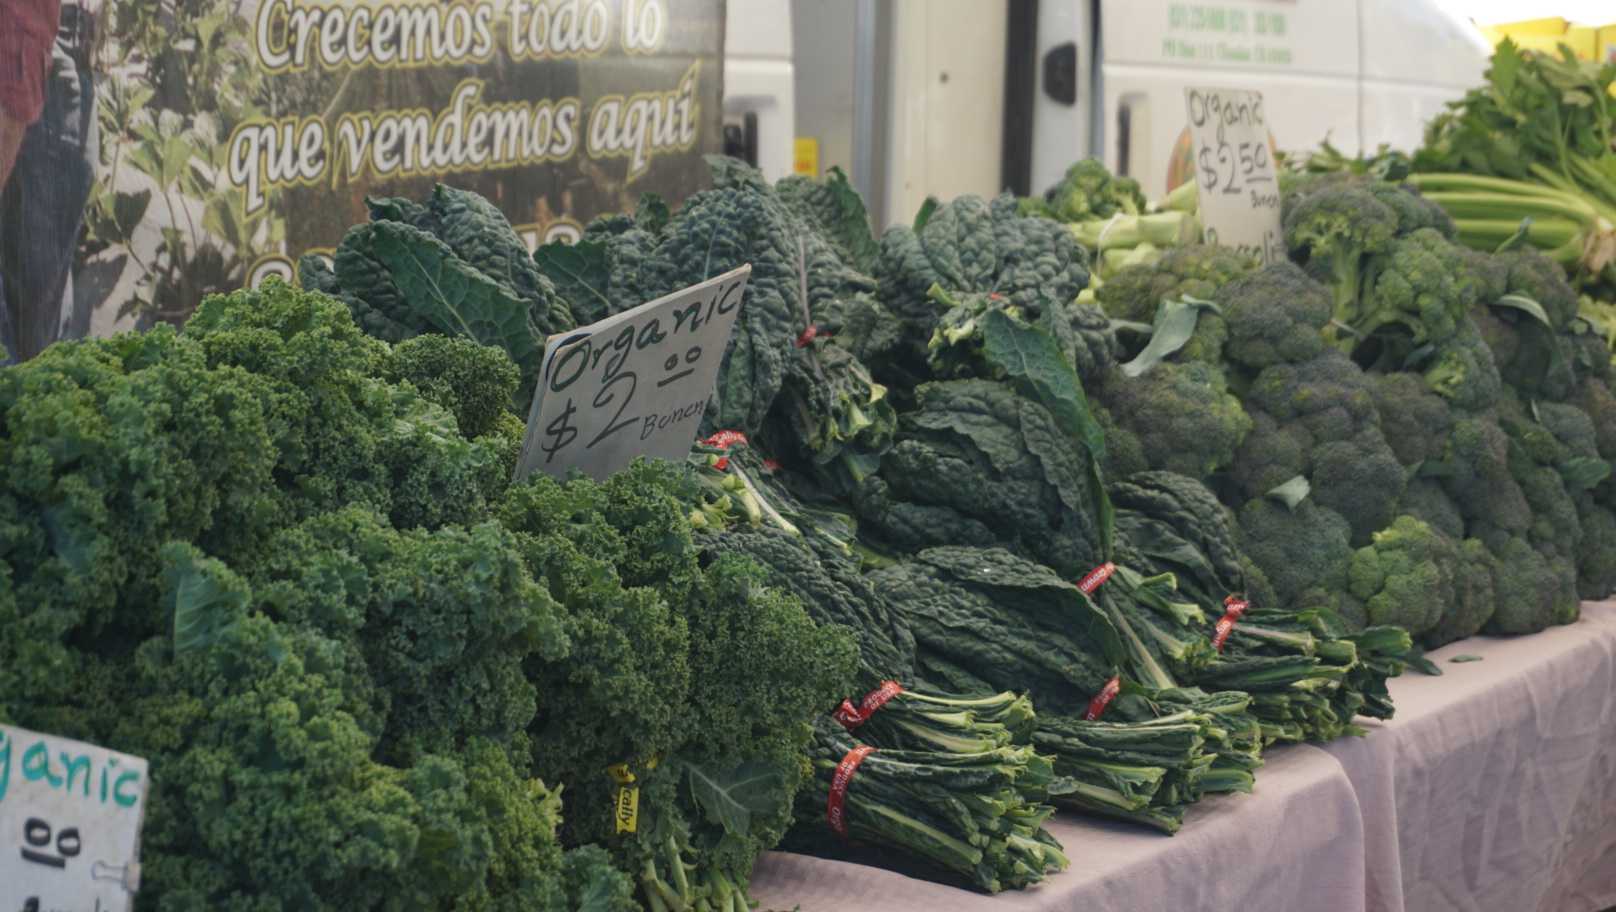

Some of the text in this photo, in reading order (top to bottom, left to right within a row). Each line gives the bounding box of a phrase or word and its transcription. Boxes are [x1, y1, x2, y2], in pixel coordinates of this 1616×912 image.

[257, 0, 493, 68] Crecemos
[229, 62, 698, 213] que vendemos aquí
[1189, 89, 1264, 146] Organic
[546, 281, 741, 392] Organic
